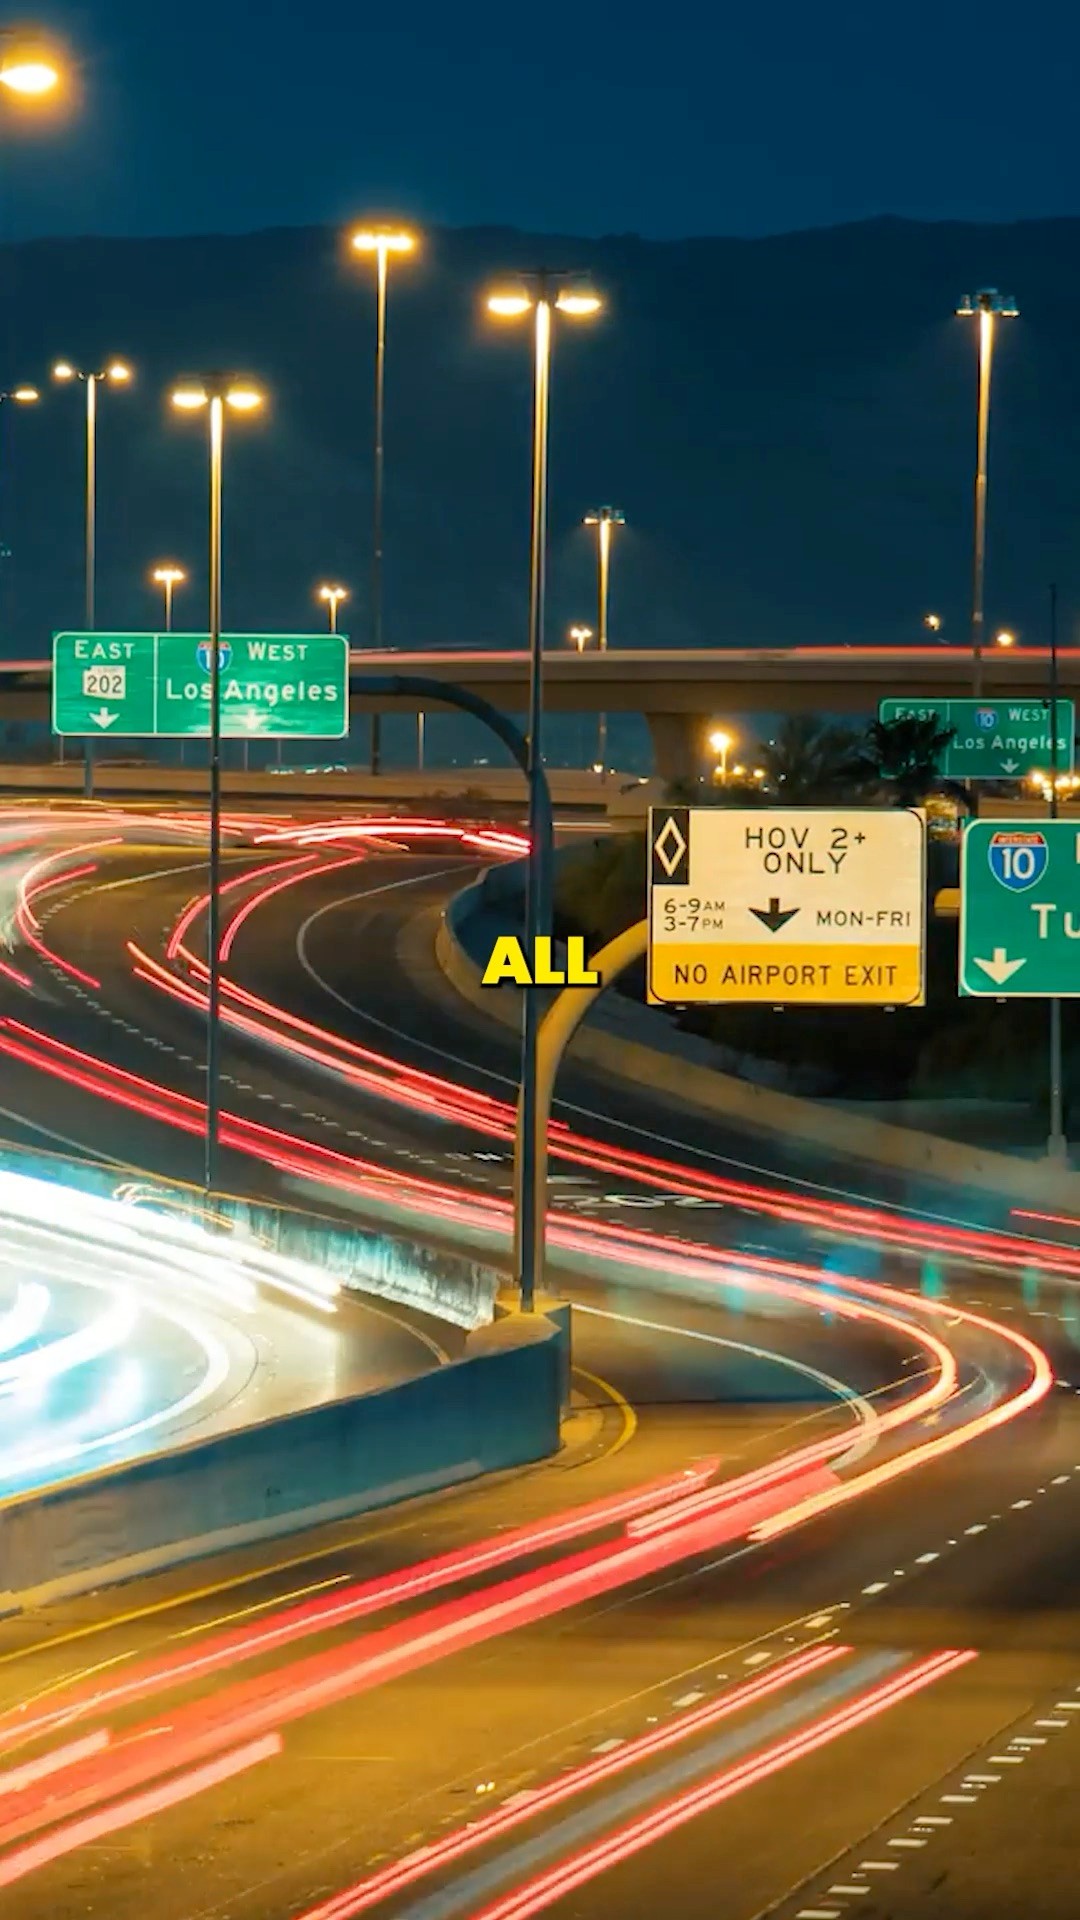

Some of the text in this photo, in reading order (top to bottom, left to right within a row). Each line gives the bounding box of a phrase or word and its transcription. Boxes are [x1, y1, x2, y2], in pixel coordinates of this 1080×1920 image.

[75, 640, 135, 660] EAST
[247, 641, 309, 661] WEST
[87, 674, 123, 694] 202
[166, 678, 338, 707] Los Angeles
[980, 708, 1049, 728] 10 WEST
[953, 735, 1067, 754] Los Angeles
[745, 827, 867, 850] HOV 2+
[763, 852, 848, 875] ONLY
[1001, 847, 1035, 880] 10
[816, 910, 912, 928] MON-FRI
[674, 964, 898, 987] NO AIRPORT EXIT
